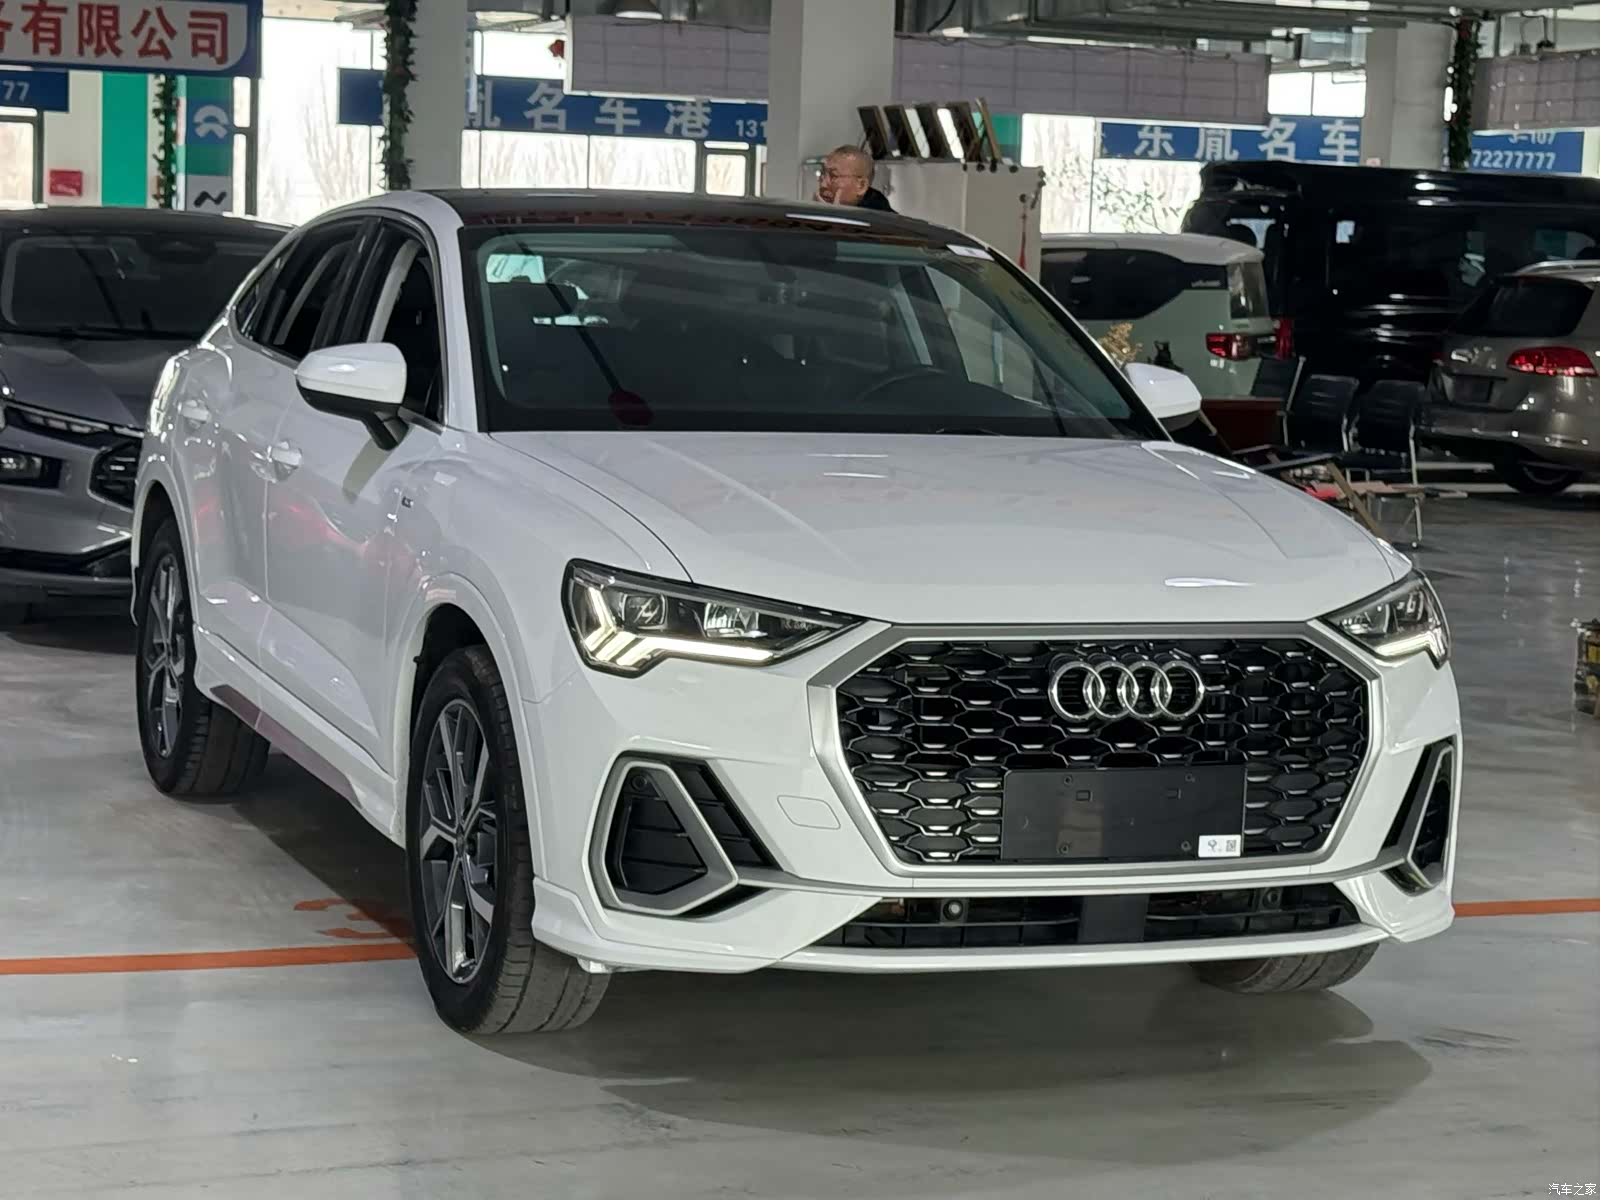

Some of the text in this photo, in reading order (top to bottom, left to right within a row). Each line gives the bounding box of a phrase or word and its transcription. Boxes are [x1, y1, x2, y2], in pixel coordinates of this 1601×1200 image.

[0, 0, 229, 65] 有限公司
[1134, 117, 1361, 166] 东胤名车
[1464, 148, 1557, 170] 72277777
